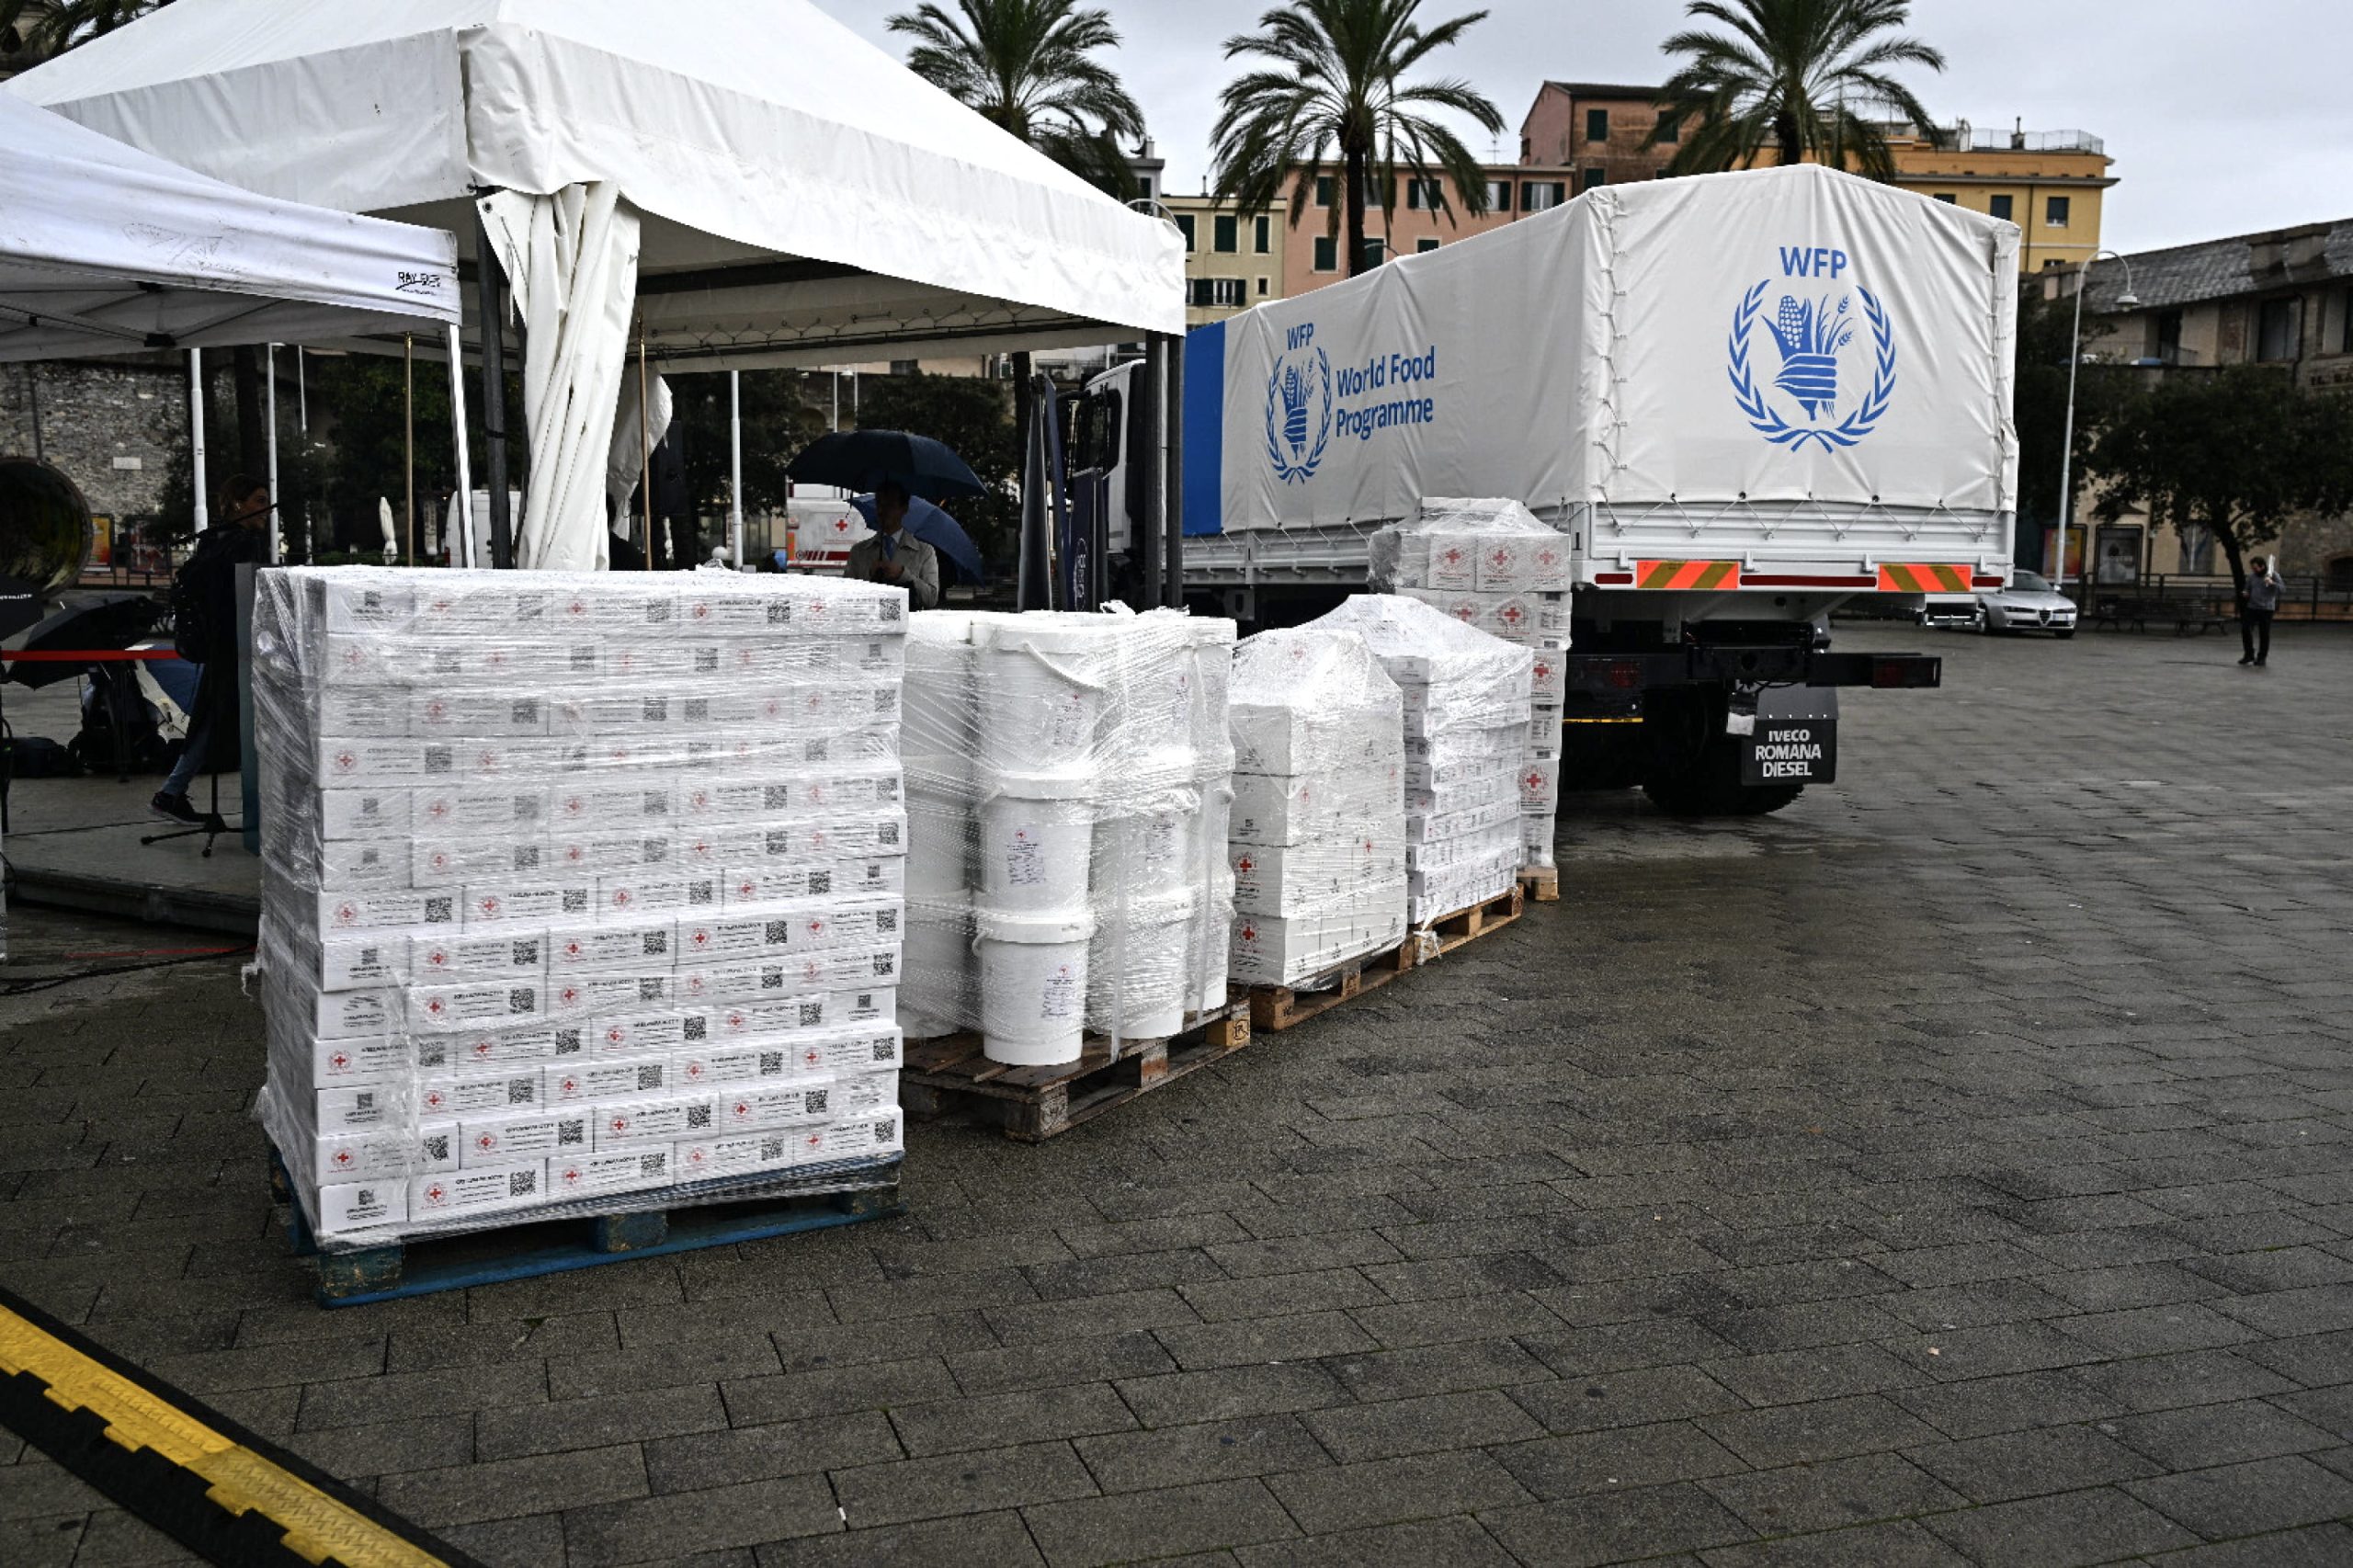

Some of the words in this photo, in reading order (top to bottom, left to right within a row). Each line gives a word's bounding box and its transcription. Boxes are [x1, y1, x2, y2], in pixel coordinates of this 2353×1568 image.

[1779, 246, 1847, 279] WFP
[1287, 322, 1314, 351] WFP
[1336, 356, 1386, 398] World
[1391, 346, 1435, 384] Food
[1336, 397, 1434, 440] Programme
[1768, 729, 1812, 743] IVECO
[1755, 744, 1822, 761] ROMANA
[1762, 761, 1813, 778] DIESEL
